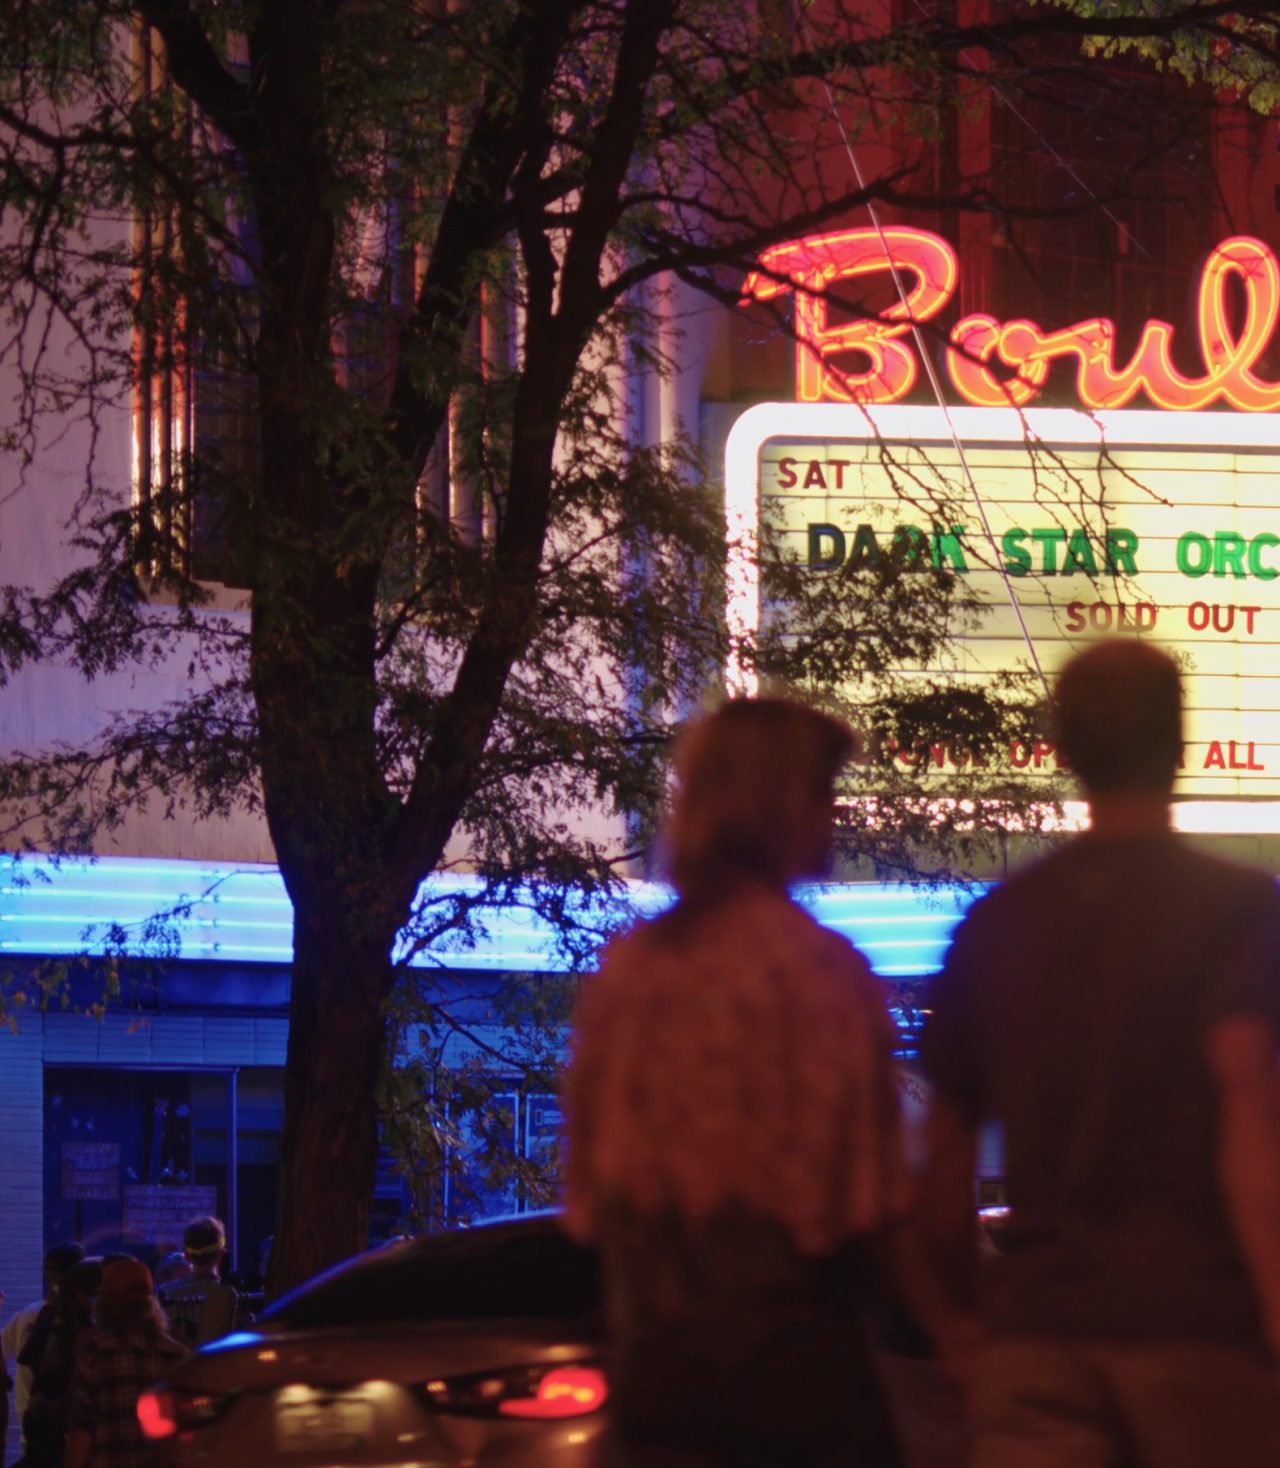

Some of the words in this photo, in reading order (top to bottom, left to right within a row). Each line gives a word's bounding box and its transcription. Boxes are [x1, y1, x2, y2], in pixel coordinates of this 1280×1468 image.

[778, 457, 850, 490] SAT
[807, 522, 969, 574] DARK
[1001, 527, 1140, 577] STAR
[1066, 601, 1159, 633] SOLD
[1187, 600, 1262, 635] OUT
[1203, 739, 1265, 771] ALL
